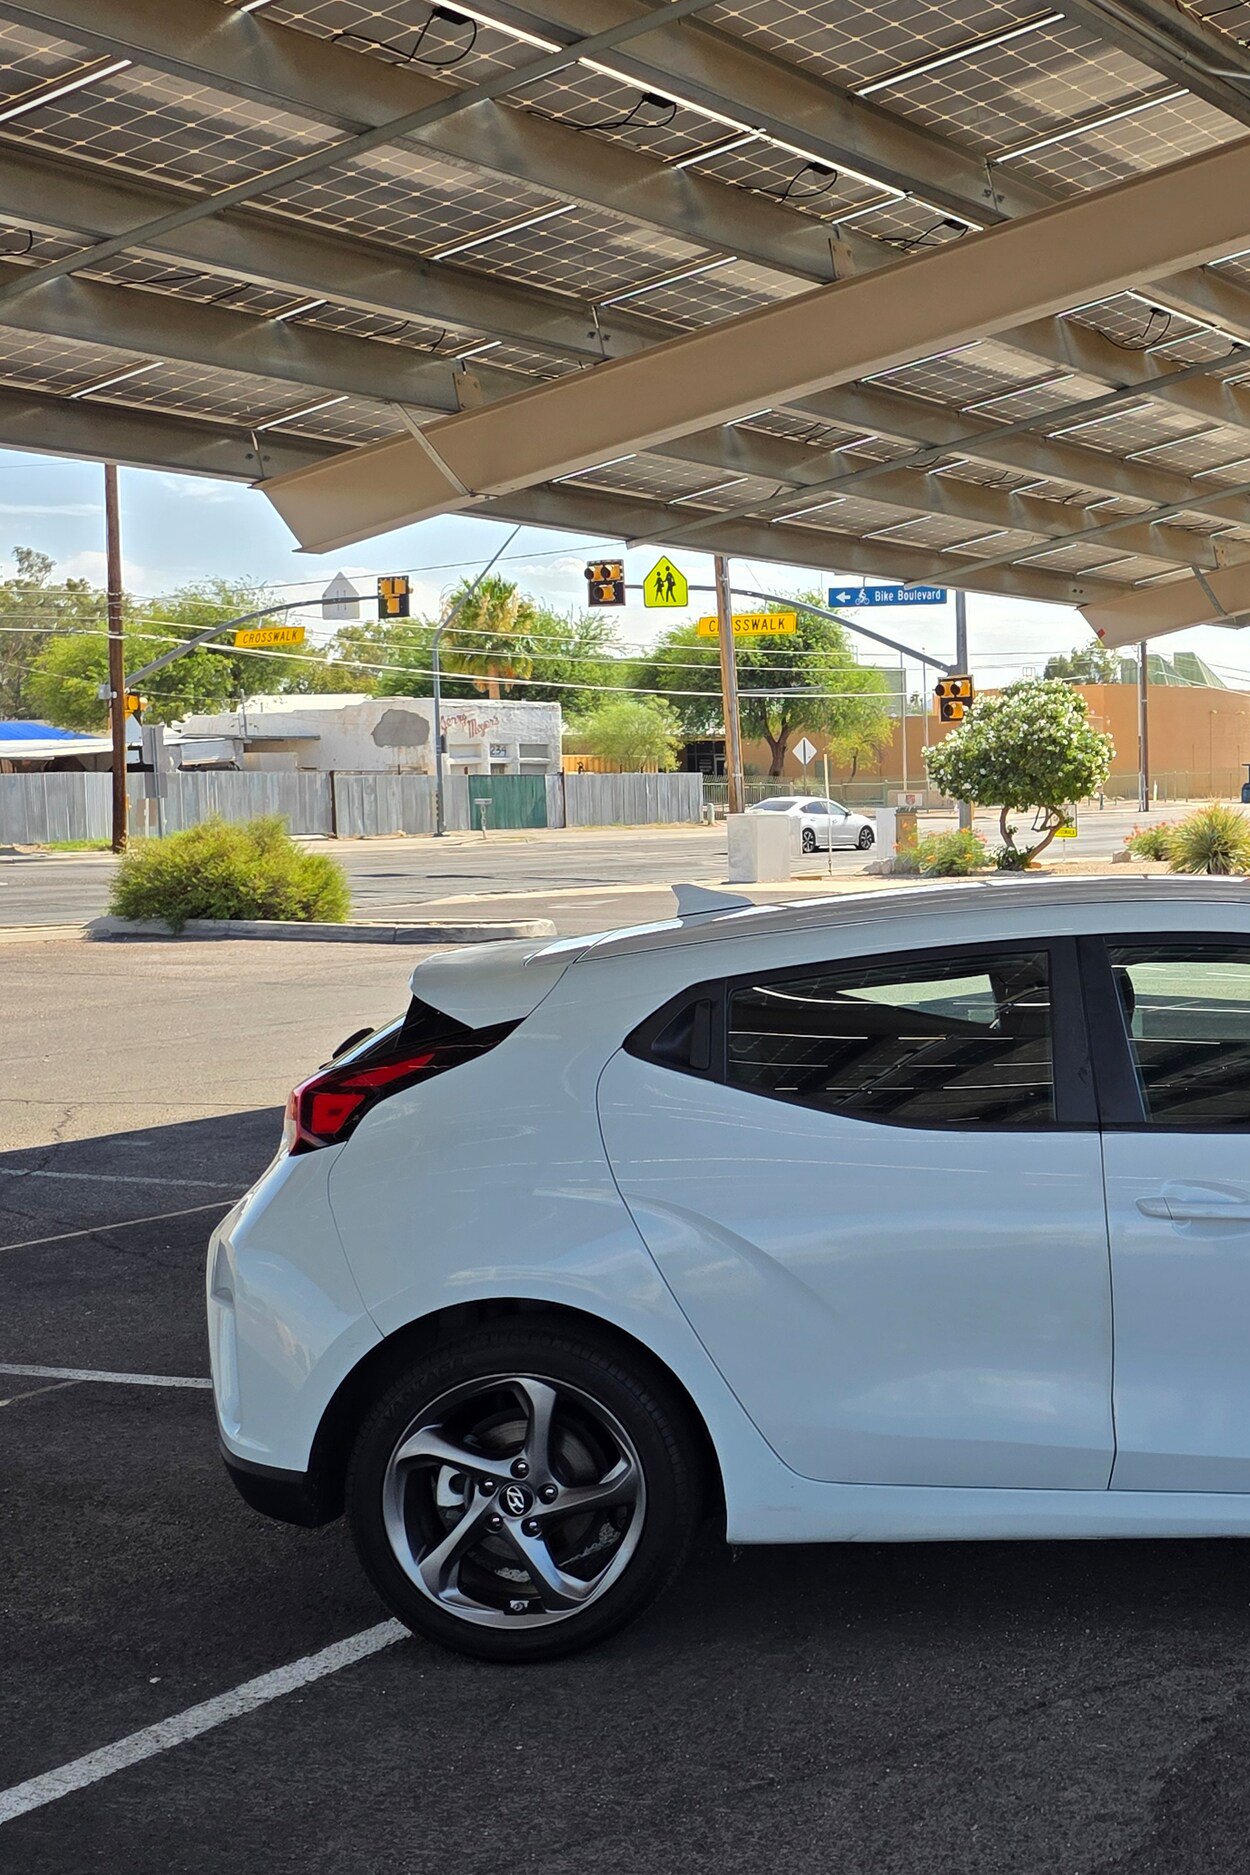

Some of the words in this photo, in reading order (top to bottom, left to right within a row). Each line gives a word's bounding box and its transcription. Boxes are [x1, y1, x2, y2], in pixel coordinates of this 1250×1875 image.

[874, 590, 894, 602] Bike
[897, 589, 941, 601] Boulevard
[708, 618, 785, 632] CSSWALK
[242, 630, 298, 644] CROSSWALK
